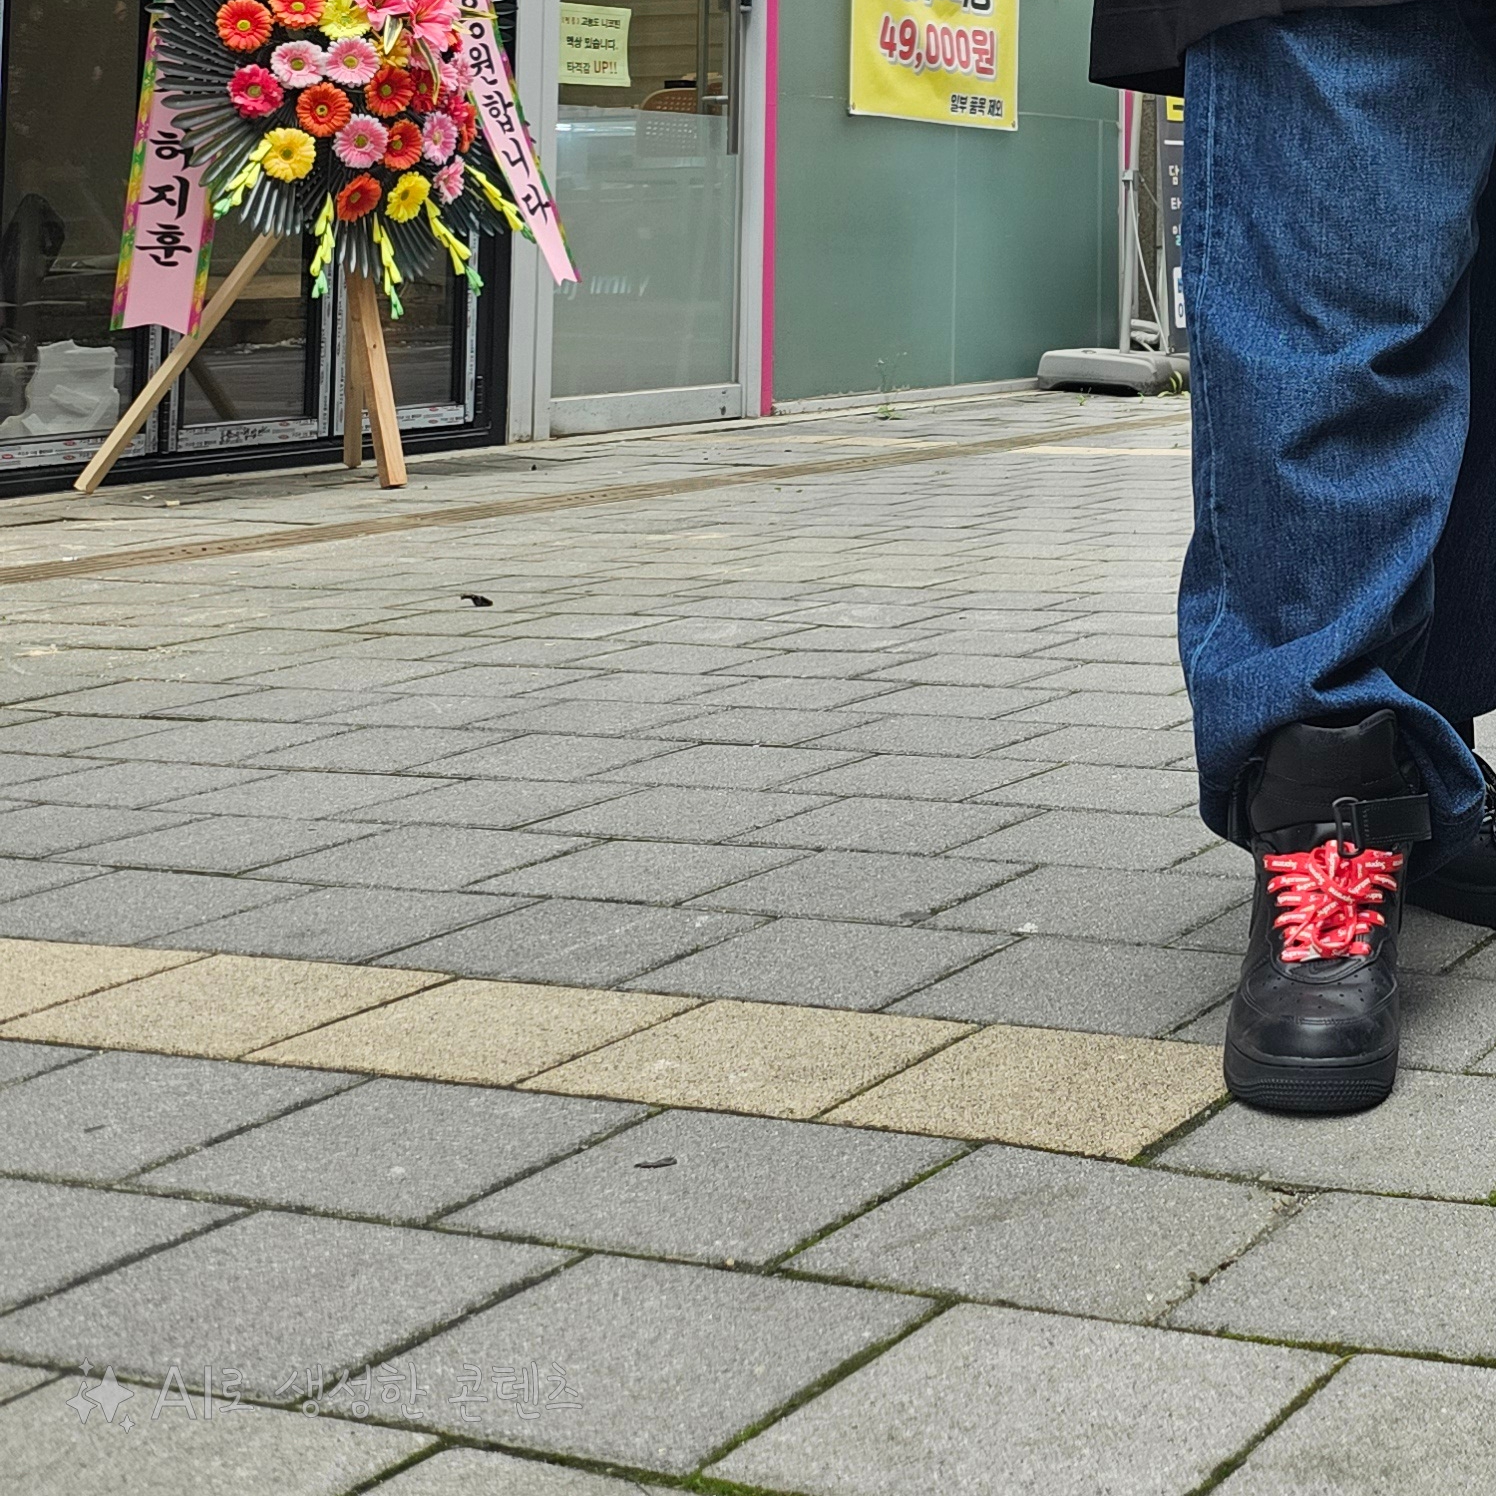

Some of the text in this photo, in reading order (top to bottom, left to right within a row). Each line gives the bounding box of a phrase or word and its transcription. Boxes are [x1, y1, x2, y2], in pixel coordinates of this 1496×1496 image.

[566, 35, 582, 49] 액상
[879, 15, 996, 76] 49,000원
[566, 60, 618, 75] 타격감 UP!!
[950, 94, 968, 113] 일부
[969, 96, 987, 116] 품목
[139, 130, 194, 267] 허지훈
